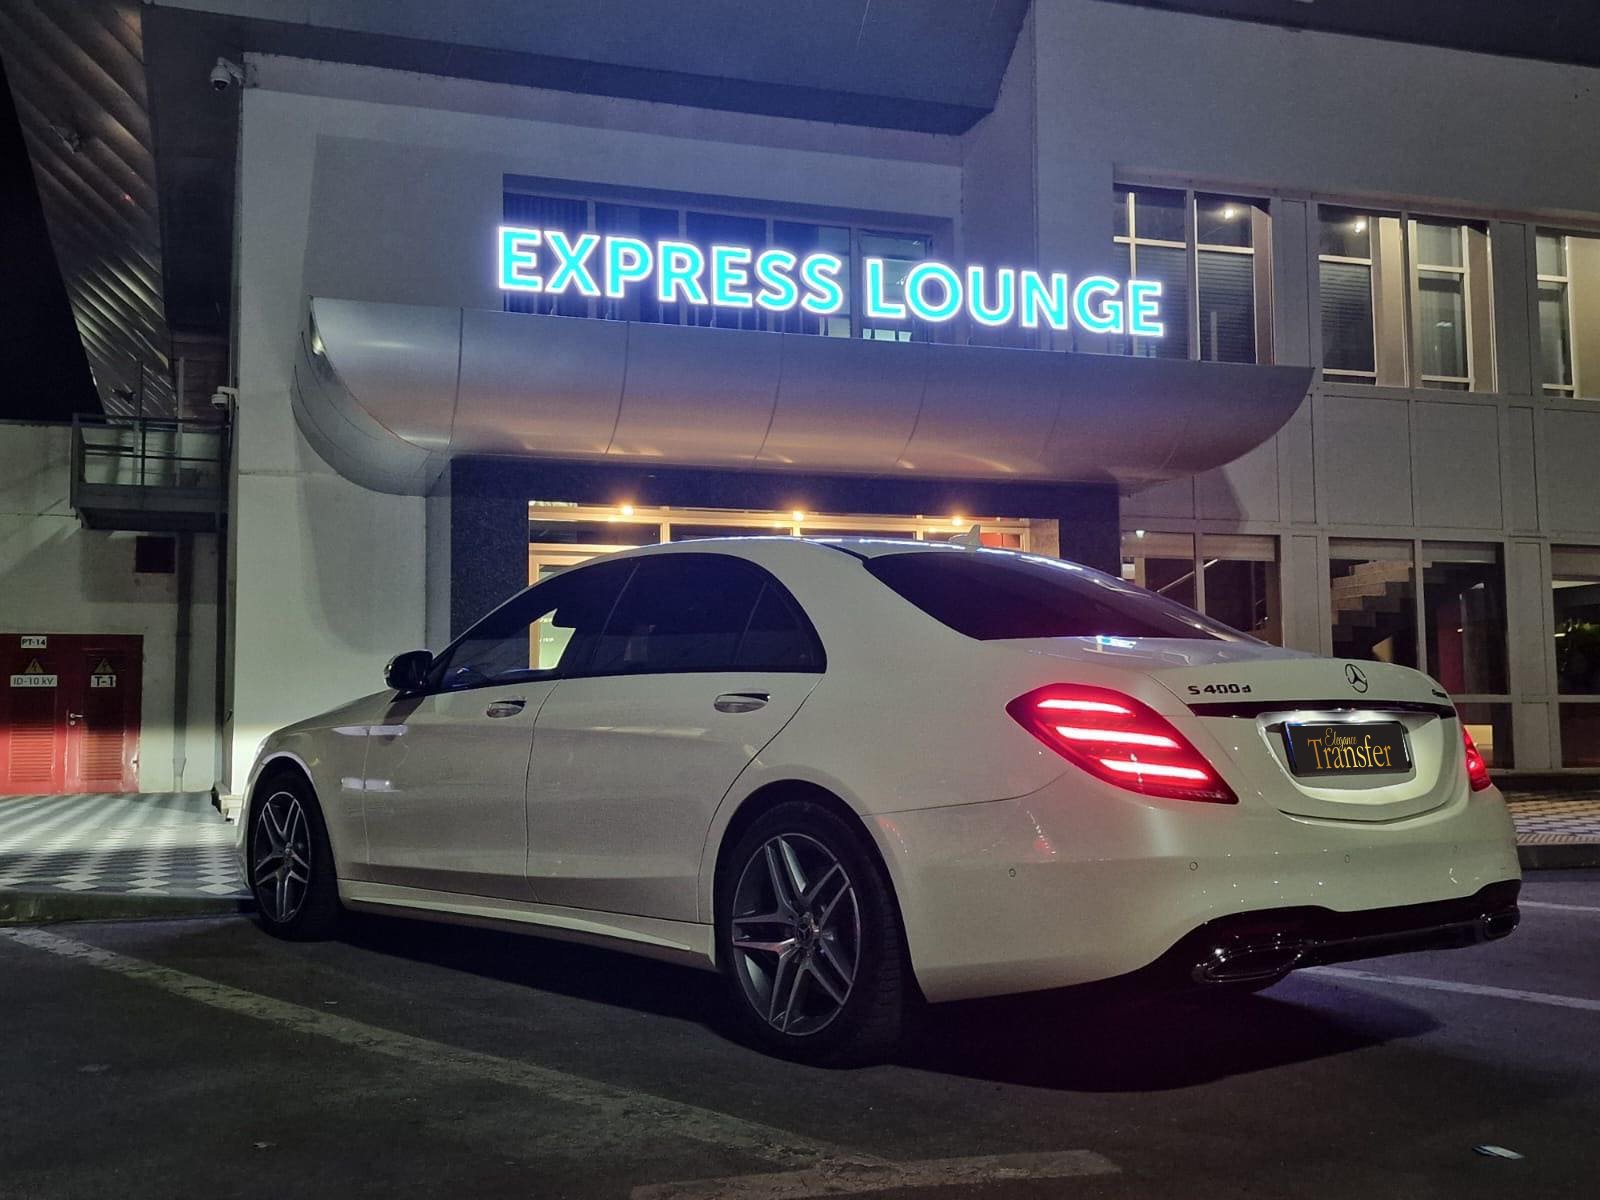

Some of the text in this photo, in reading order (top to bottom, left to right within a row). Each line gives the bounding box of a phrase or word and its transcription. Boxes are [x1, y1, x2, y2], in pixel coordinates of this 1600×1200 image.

[497, 226, 1164, 336] EXPRESS LOUNGE
[22, 638, 46, 646] PT-14
[94, 676, 115, 687] T-1
[1188, 684, 1201, 696] S
